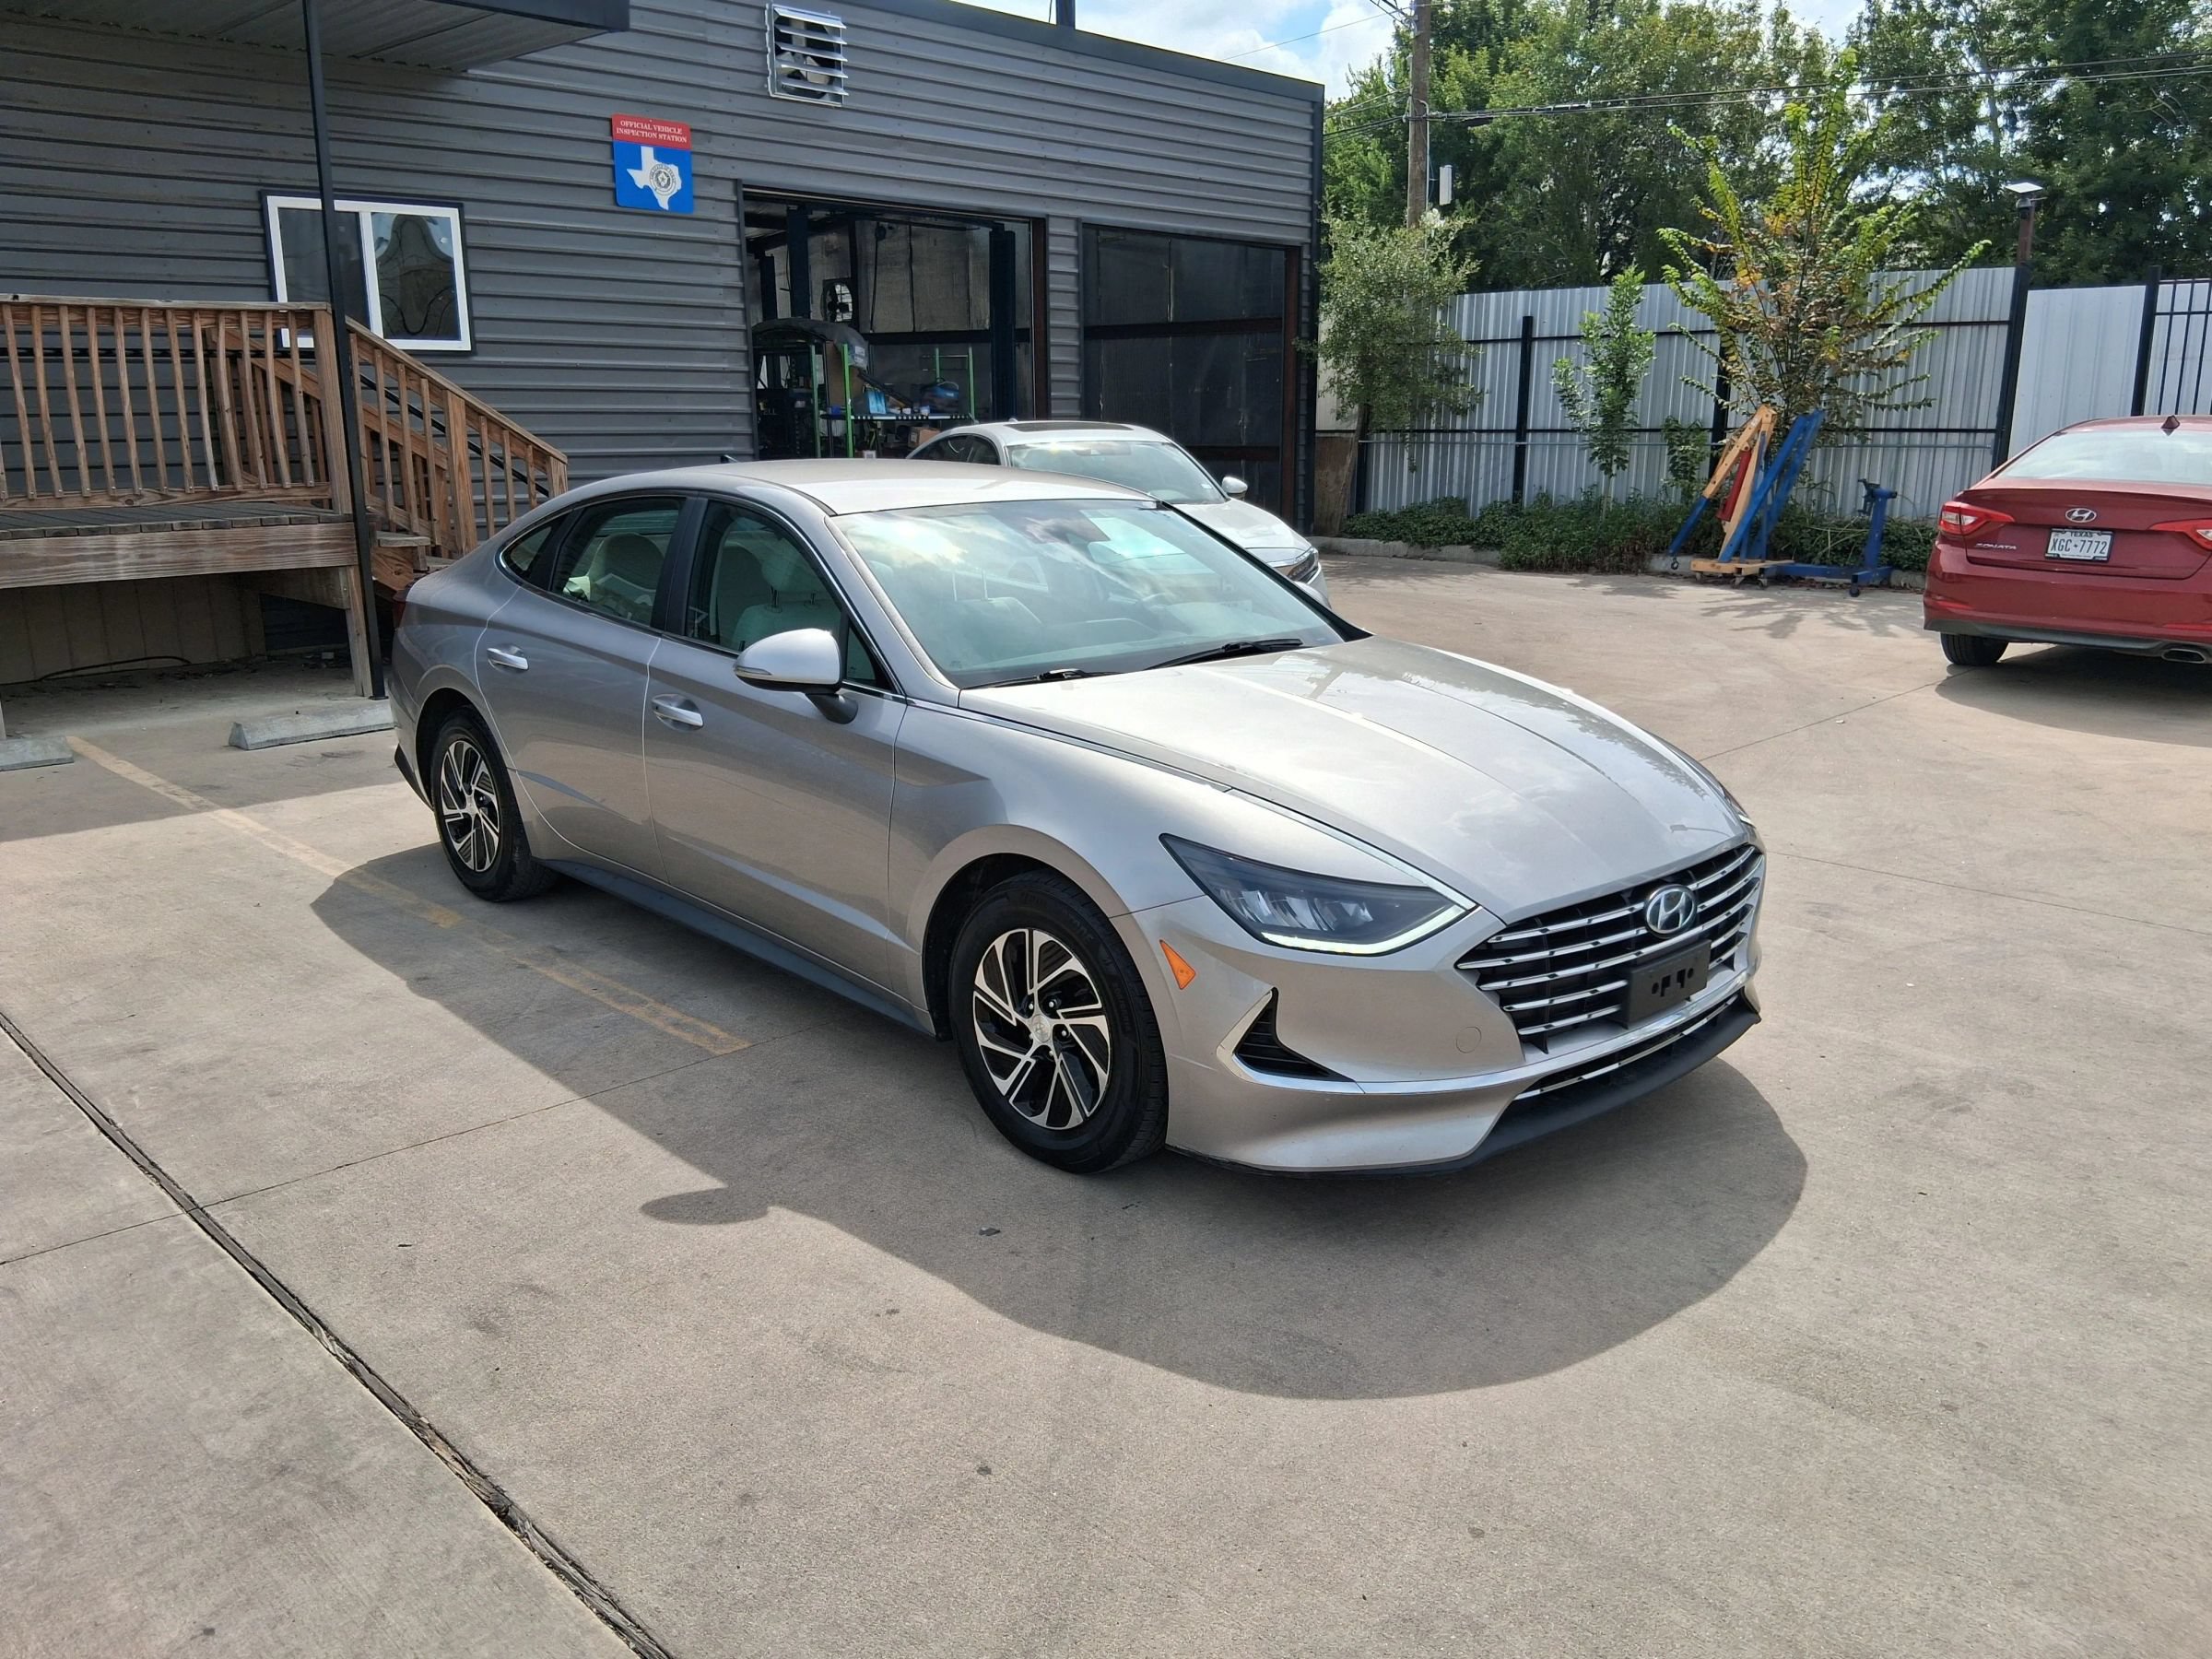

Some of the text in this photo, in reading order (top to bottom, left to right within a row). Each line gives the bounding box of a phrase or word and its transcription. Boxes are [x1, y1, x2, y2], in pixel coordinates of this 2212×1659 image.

[617, 127, 687, 143] INSPECTION STATION
[620, 120, 683, 135] OFFICIAL VEHICLE
